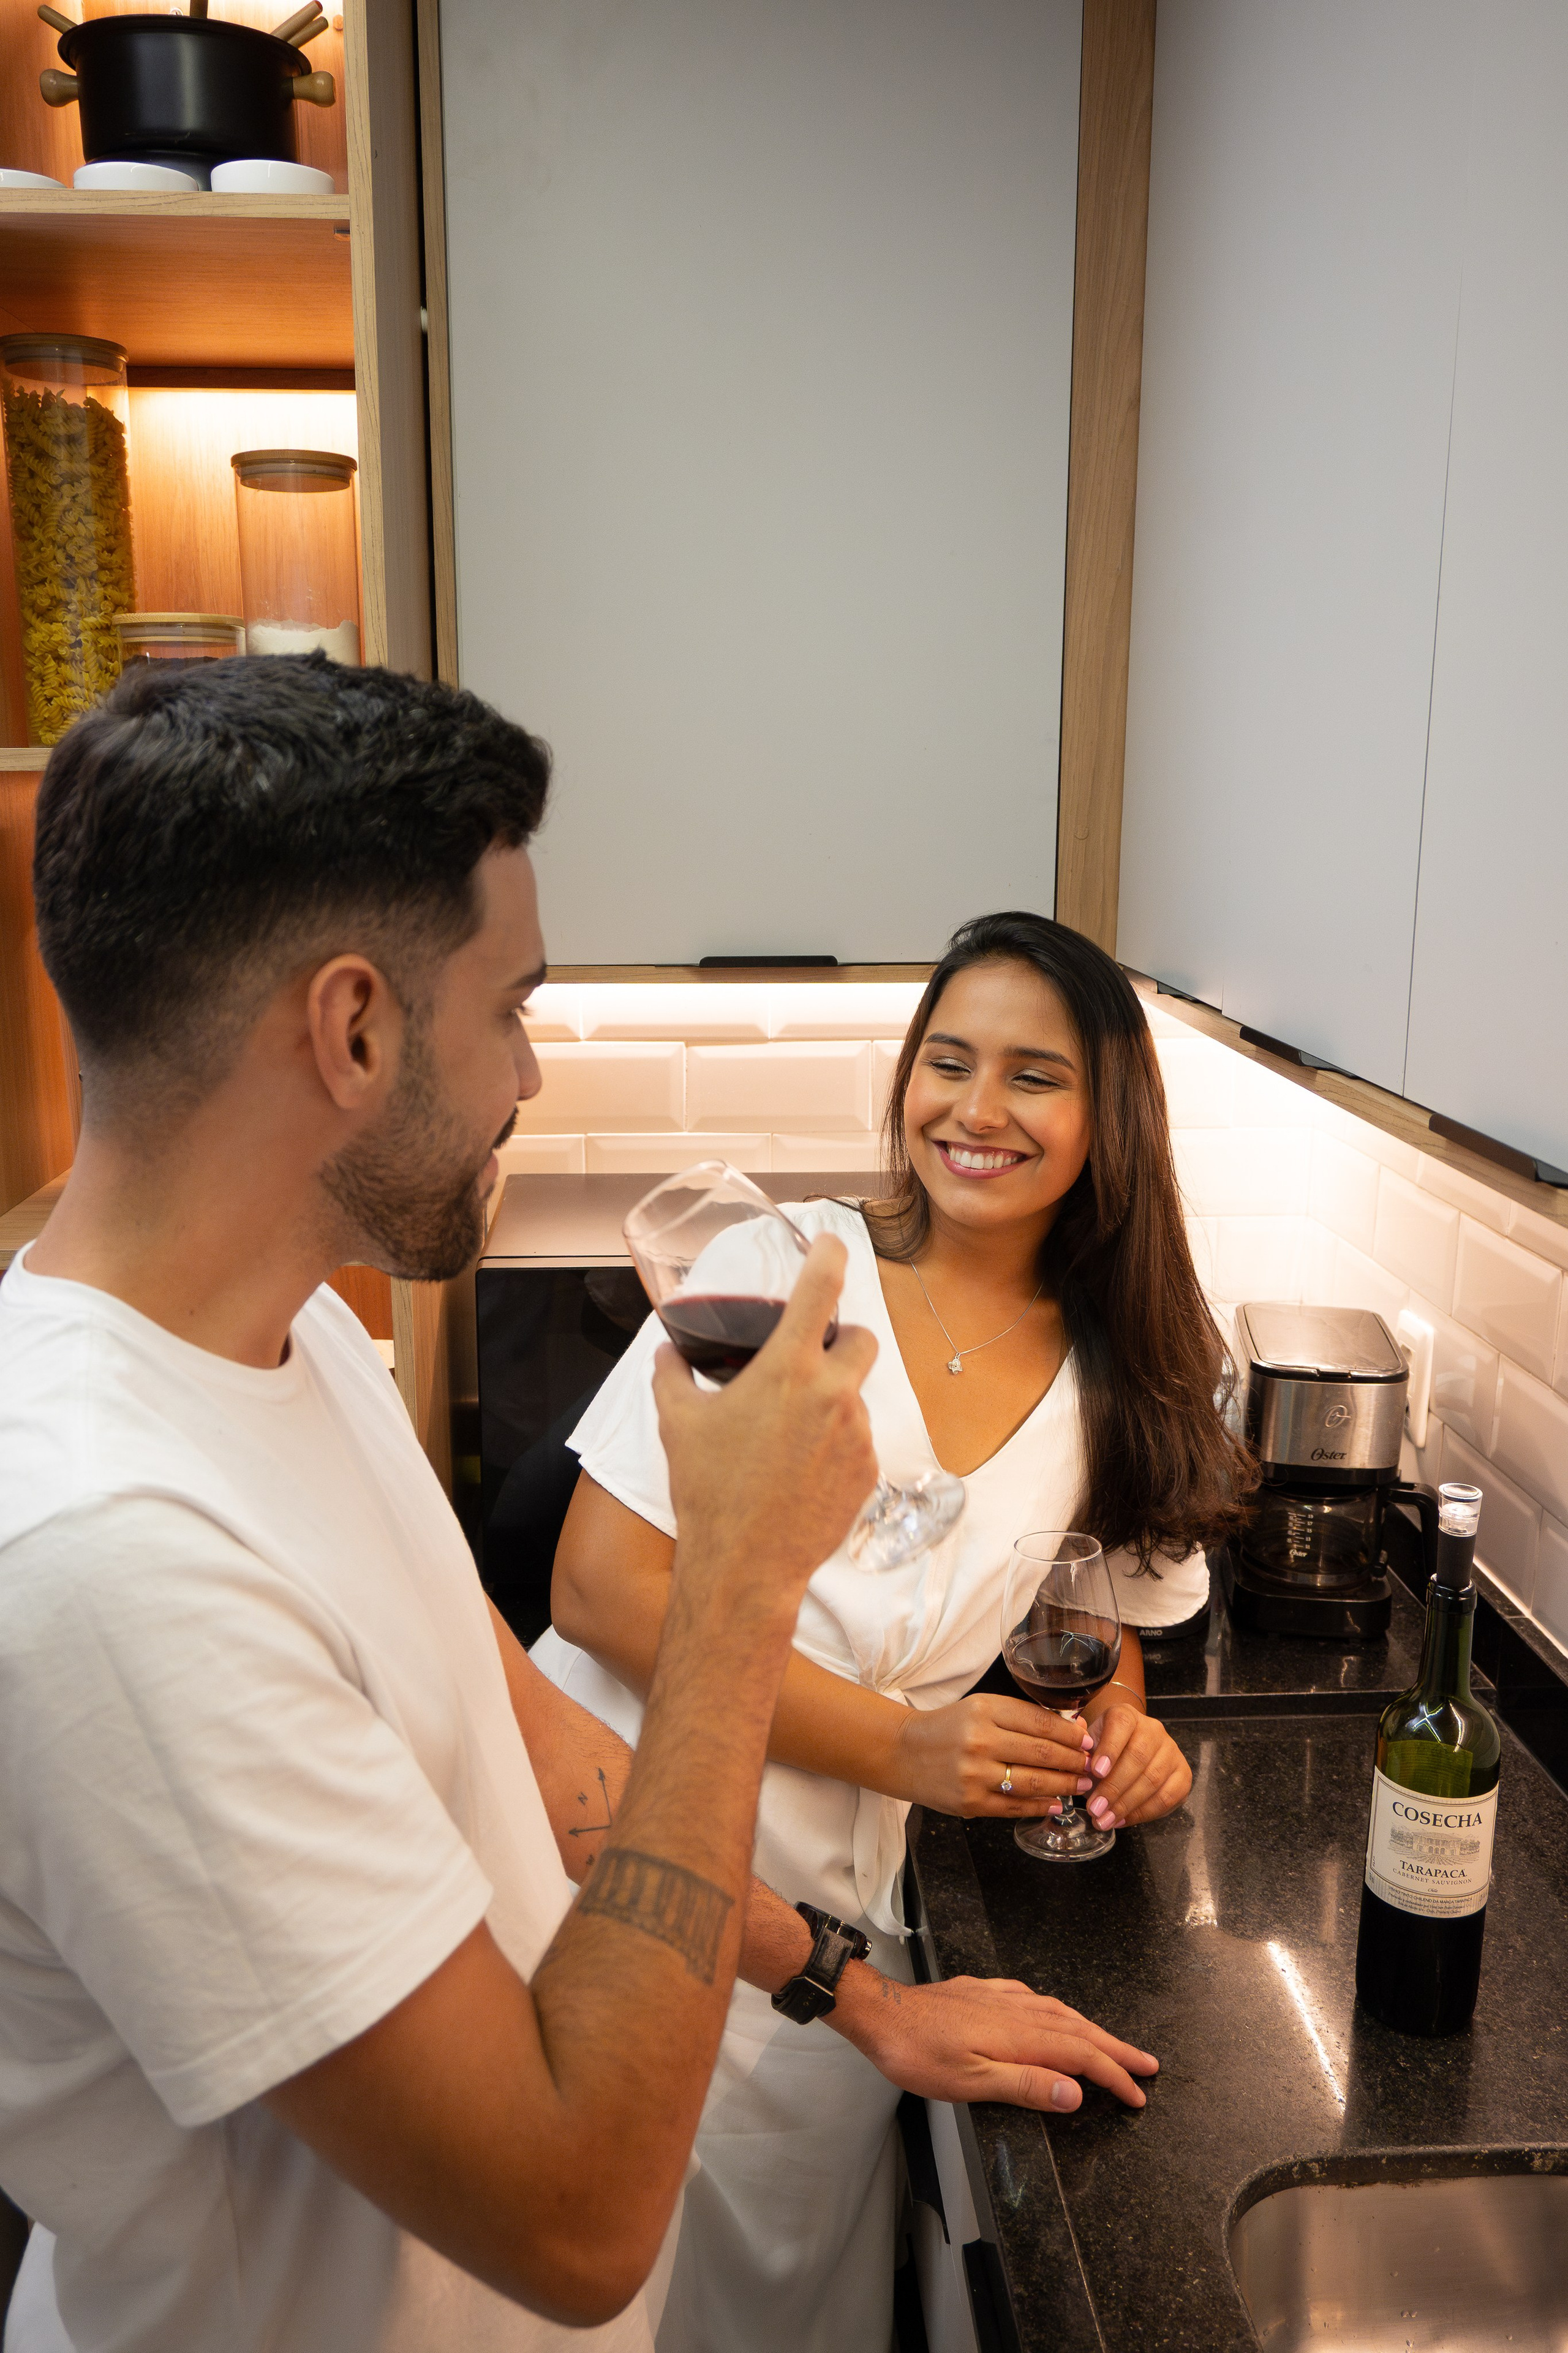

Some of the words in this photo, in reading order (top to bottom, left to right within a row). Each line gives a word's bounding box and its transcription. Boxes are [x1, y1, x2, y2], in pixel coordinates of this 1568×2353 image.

[1311, 1448, 1347, 1461] Oster
[1392, 1802, 1483, 1829] COSECHA
[1392, 1868, 1429, 1883] CABERNET
